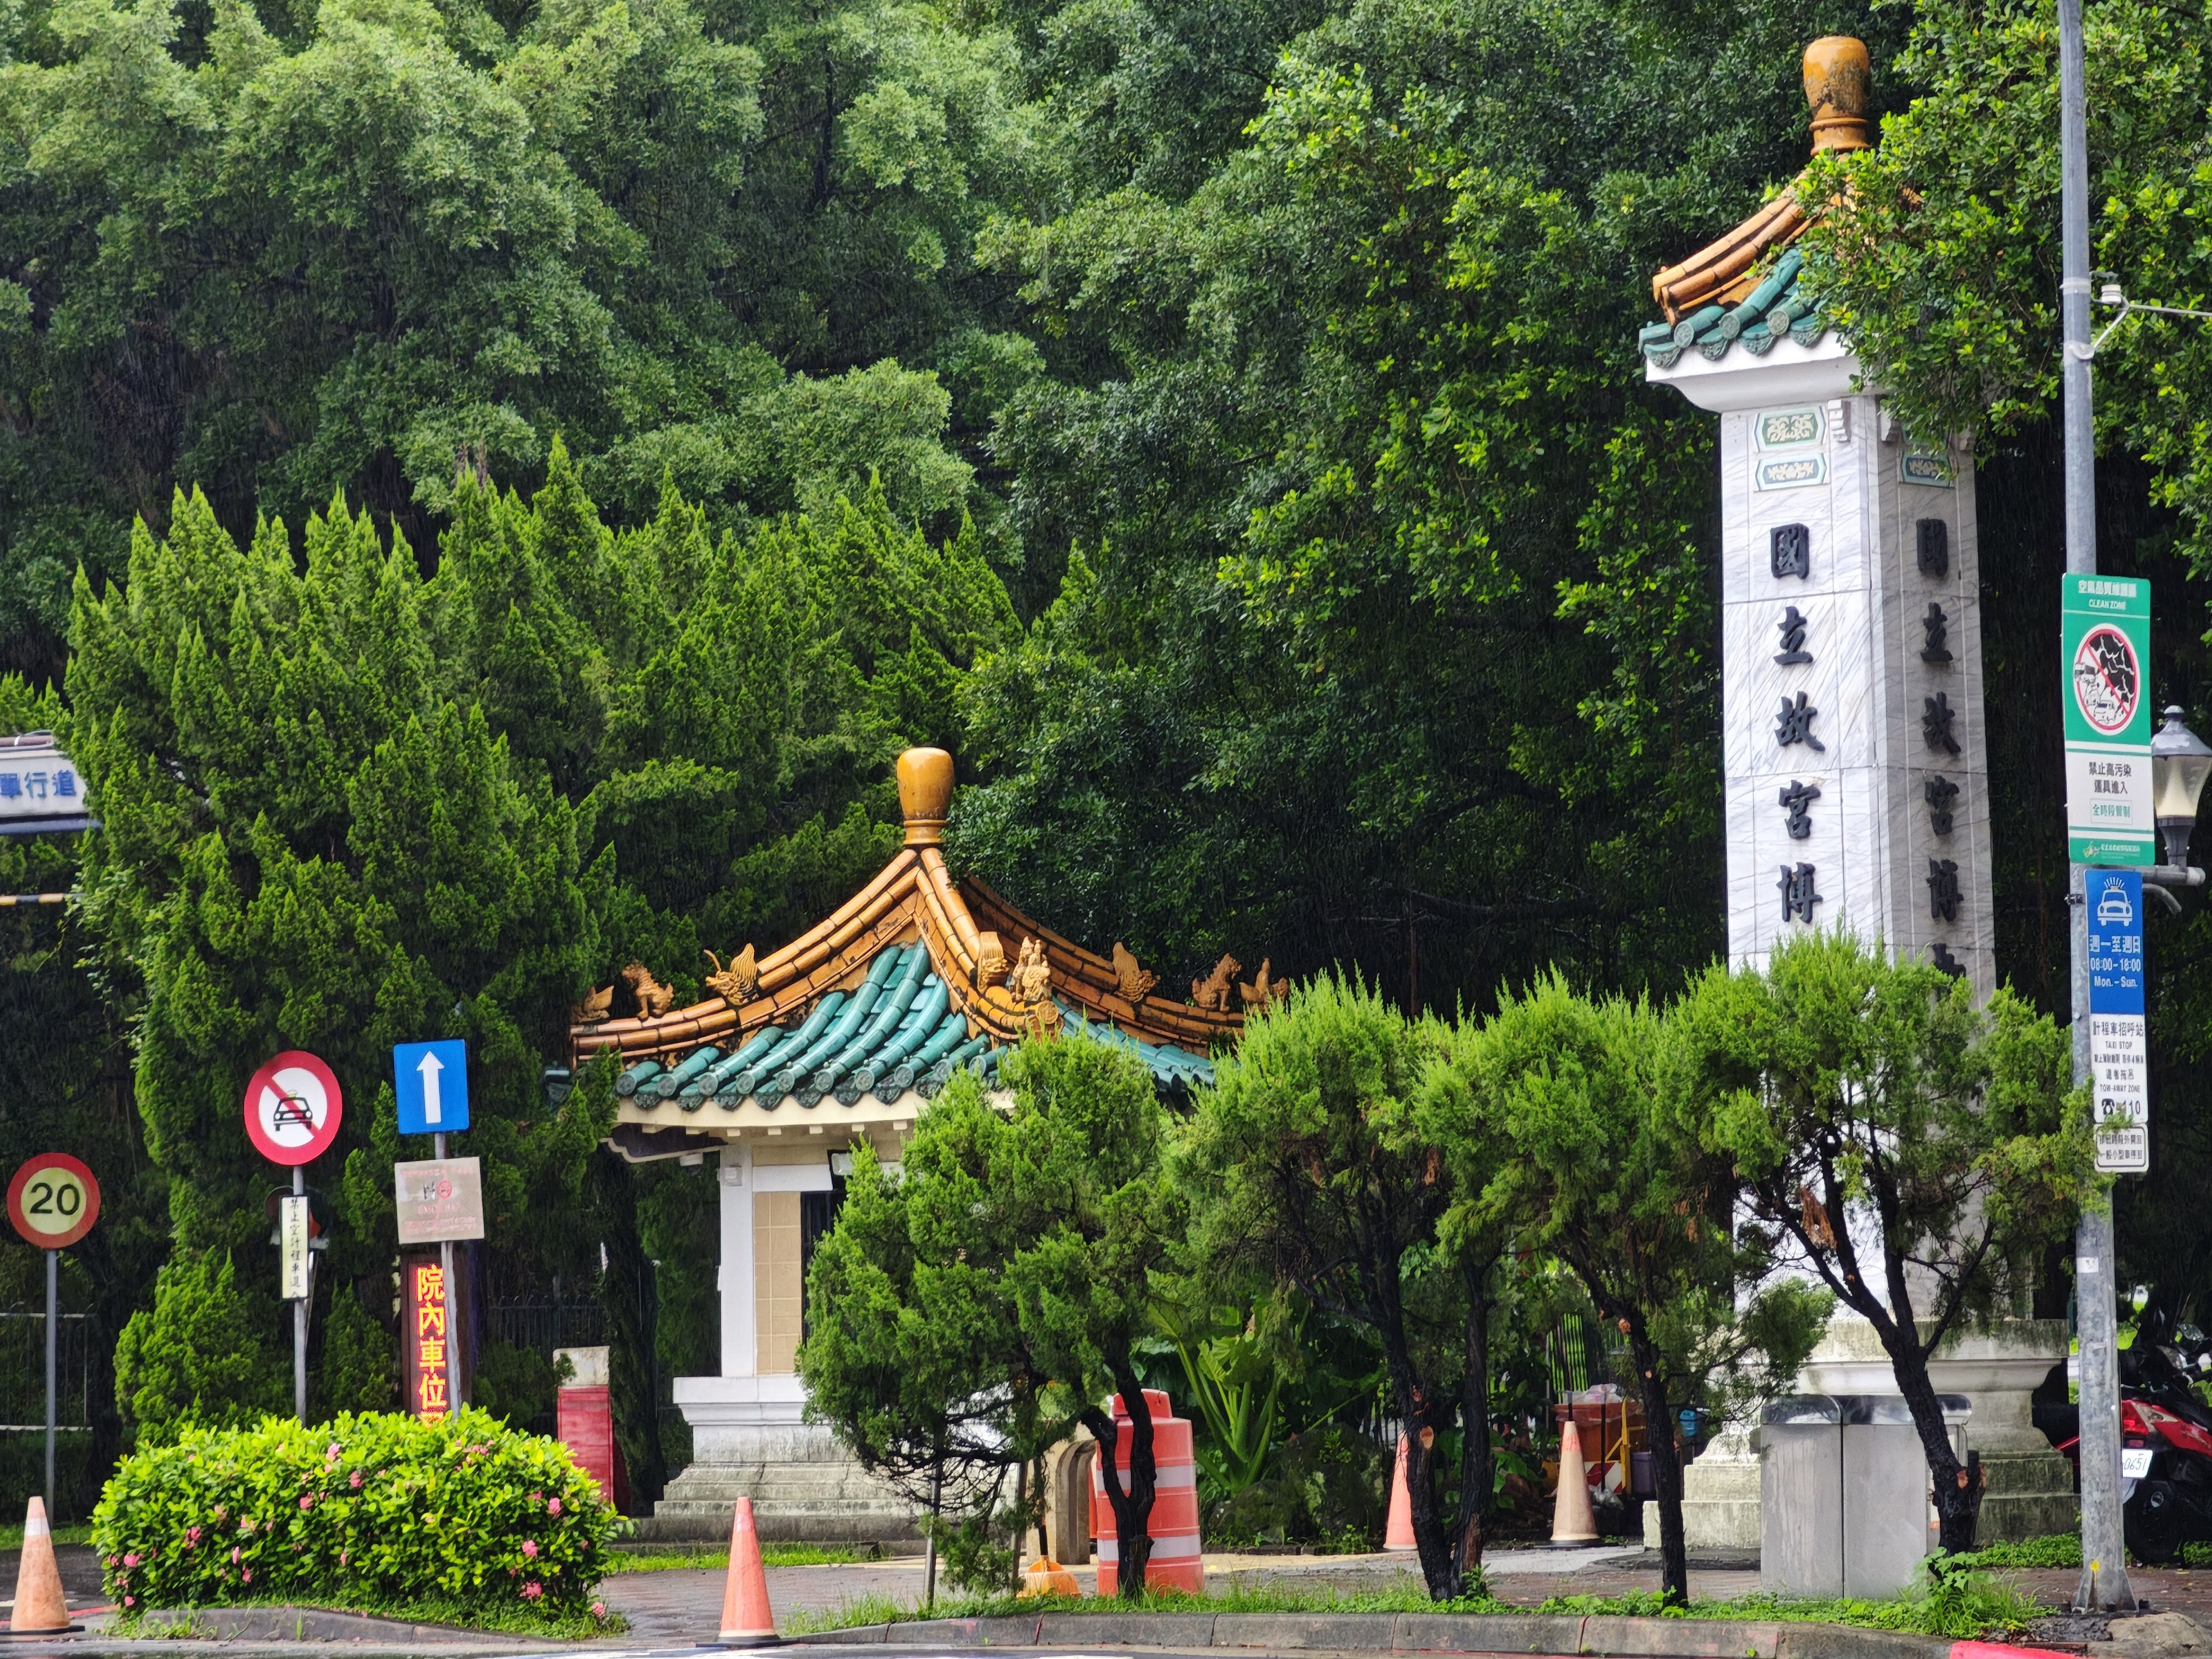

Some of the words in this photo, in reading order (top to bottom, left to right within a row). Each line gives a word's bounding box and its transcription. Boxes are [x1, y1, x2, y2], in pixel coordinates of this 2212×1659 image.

[2105, 1041, 2117, 1049] TAXI
[2119, 1041, 2133, 1049] STOP
[29, 1182, 80, 1215] 20
[416, 1263, 448, 1428] 院內車位
